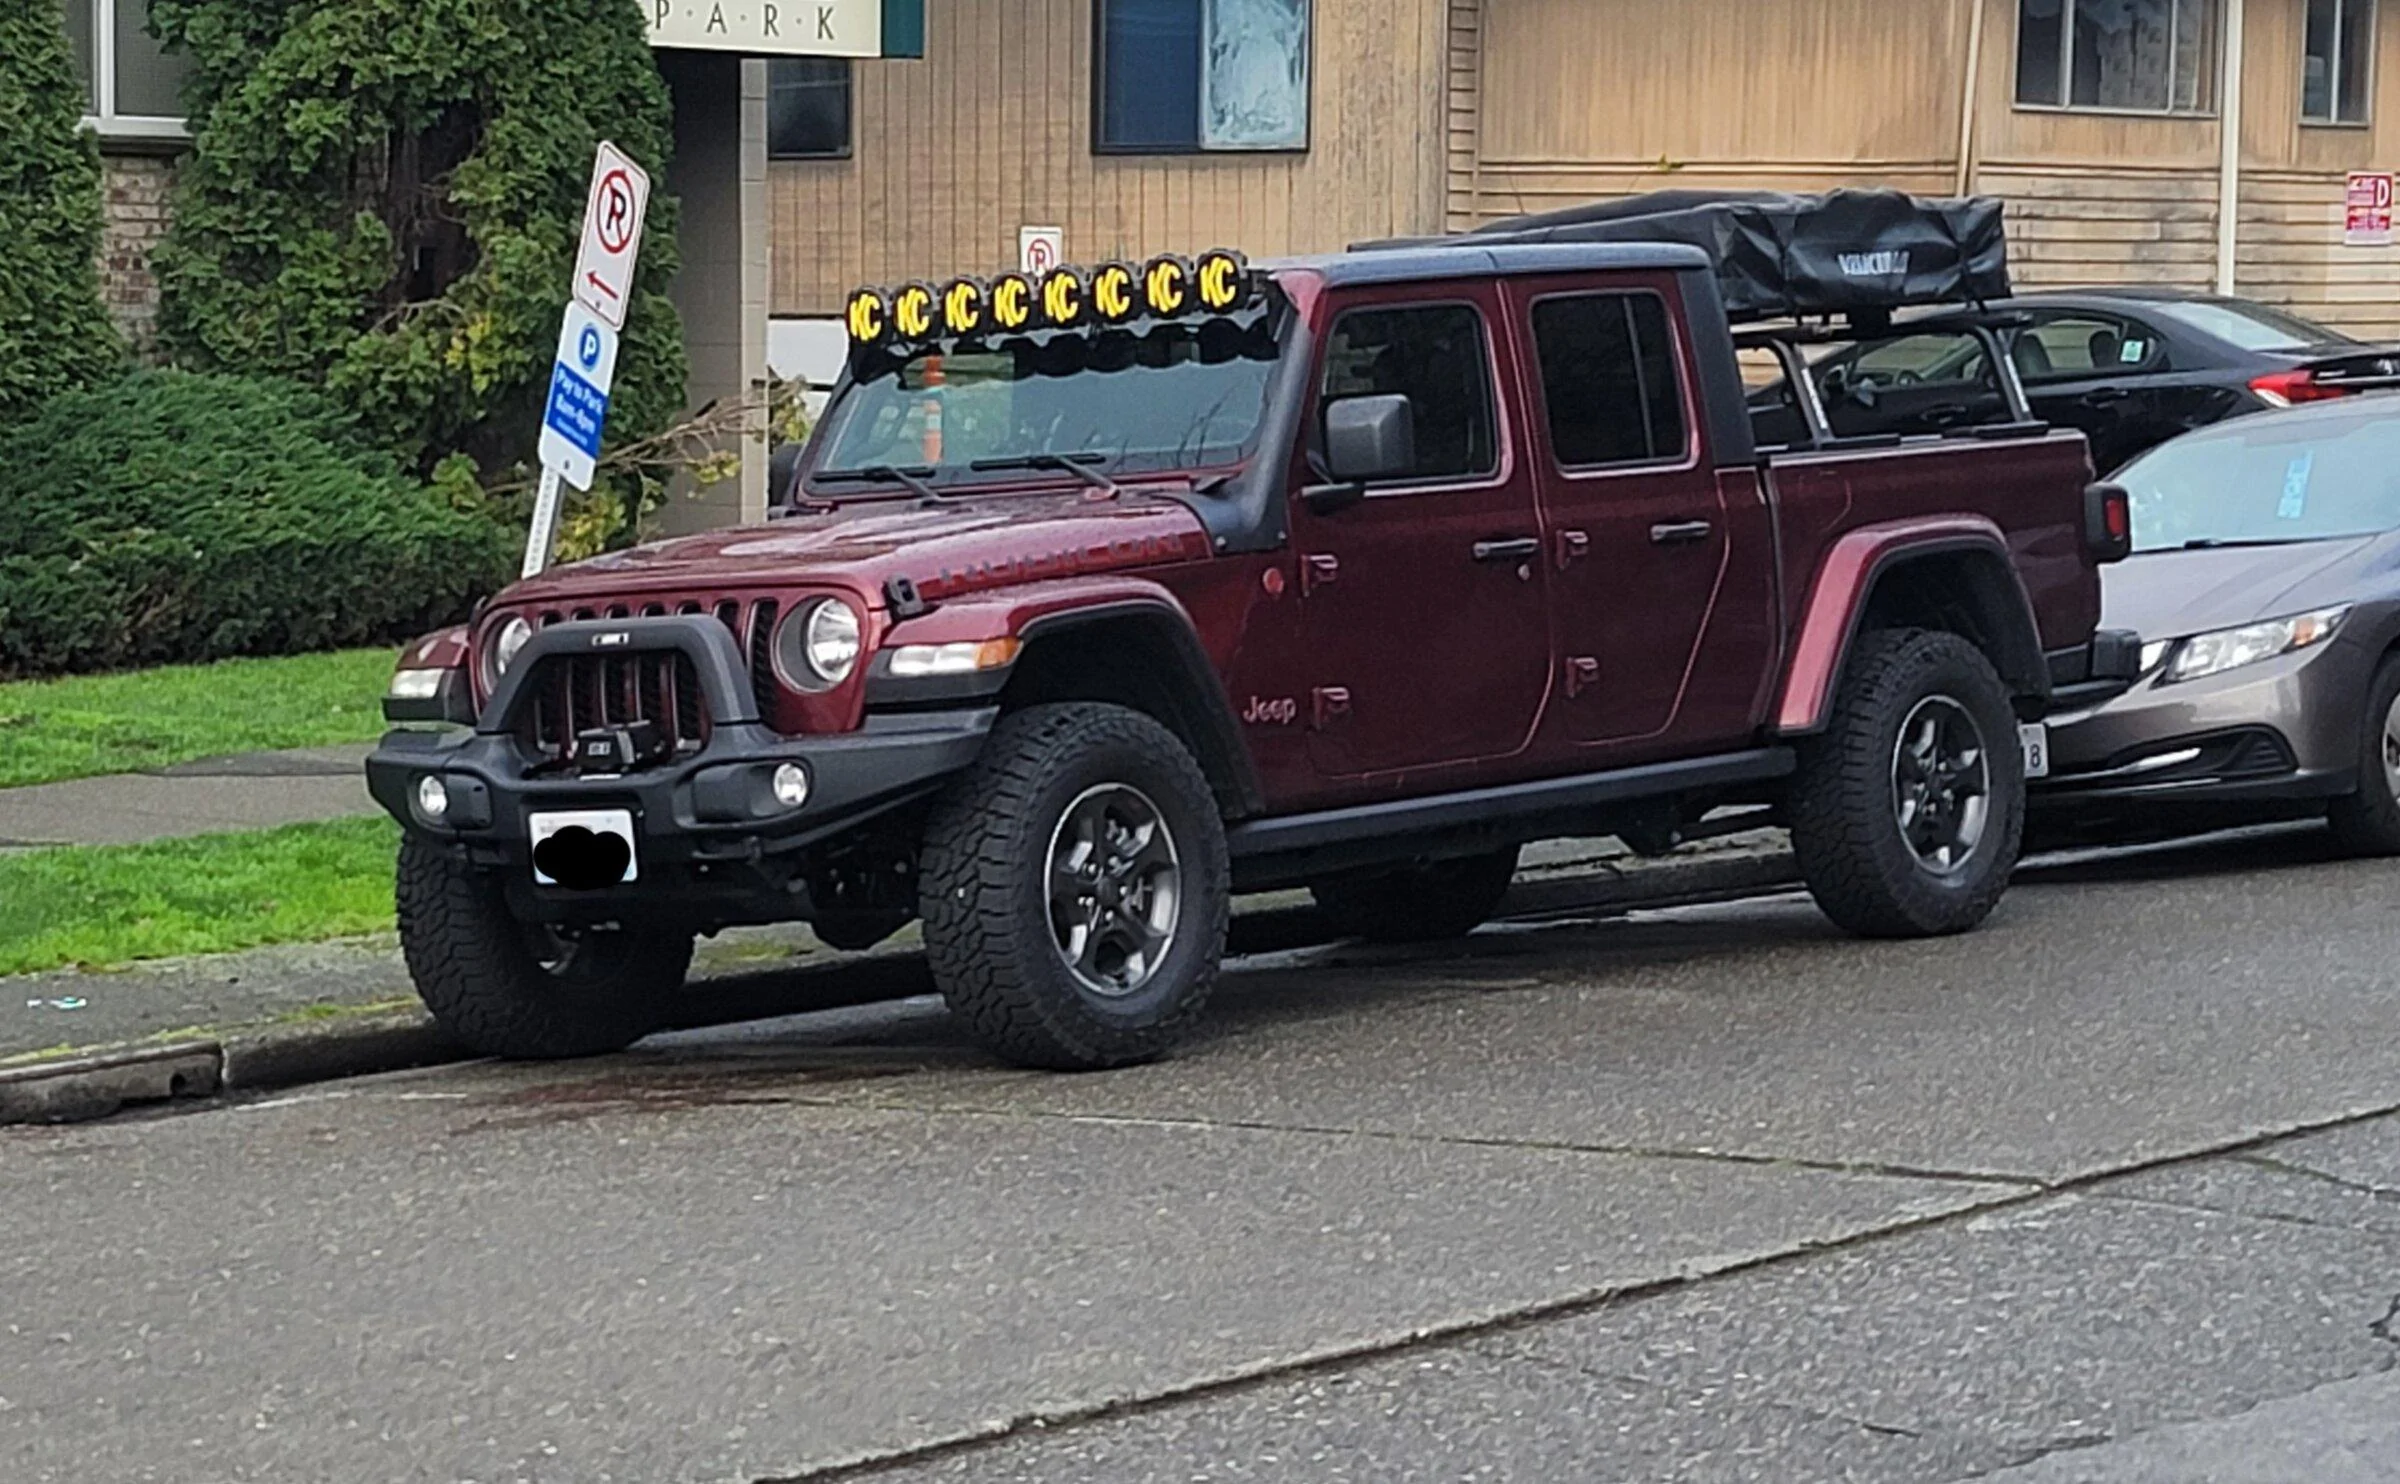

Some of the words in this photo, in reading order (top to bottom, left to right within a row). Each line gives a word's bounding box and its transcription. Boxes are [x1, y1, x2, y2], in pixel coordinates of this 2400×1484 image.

[995, 278, 1028, 327] KC
[1045, 273, 1078, 323] KC
[1096, 268, 1130, 317] KC
[1148, 262, 1182, 313] KC
[1201, 257, 1236, 308] KC
[850, 293, 881, 341] KC
[897, 288, 929, 336] KC
[945, 283, 978, 332] KC
[1242, 695, 1297, 725] Jeep
